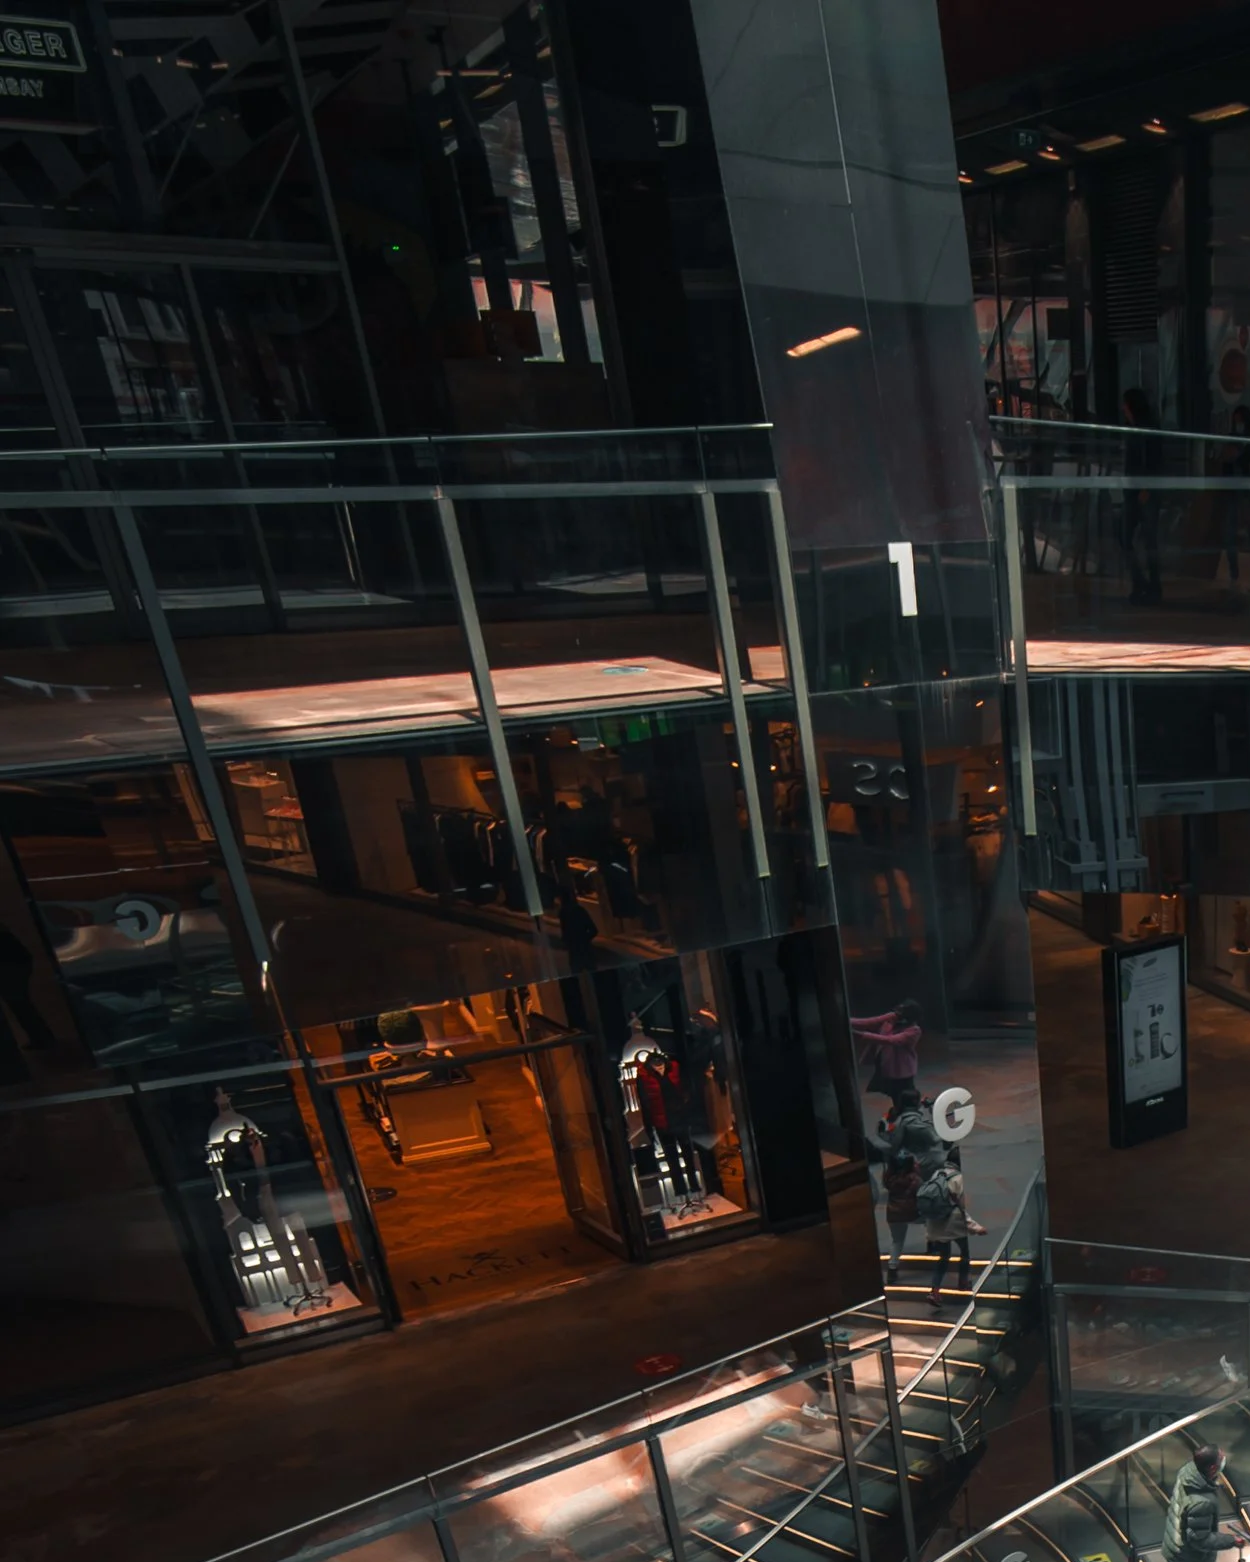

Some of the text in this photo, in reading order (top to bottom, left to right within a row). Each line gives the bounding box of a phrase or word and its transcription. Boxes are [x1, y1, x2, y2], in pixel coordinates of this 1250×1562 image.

[0, 28, 68, 59] GER
[888, 541, 918, 617] 1
[932, 1086, 976, 1142] G
